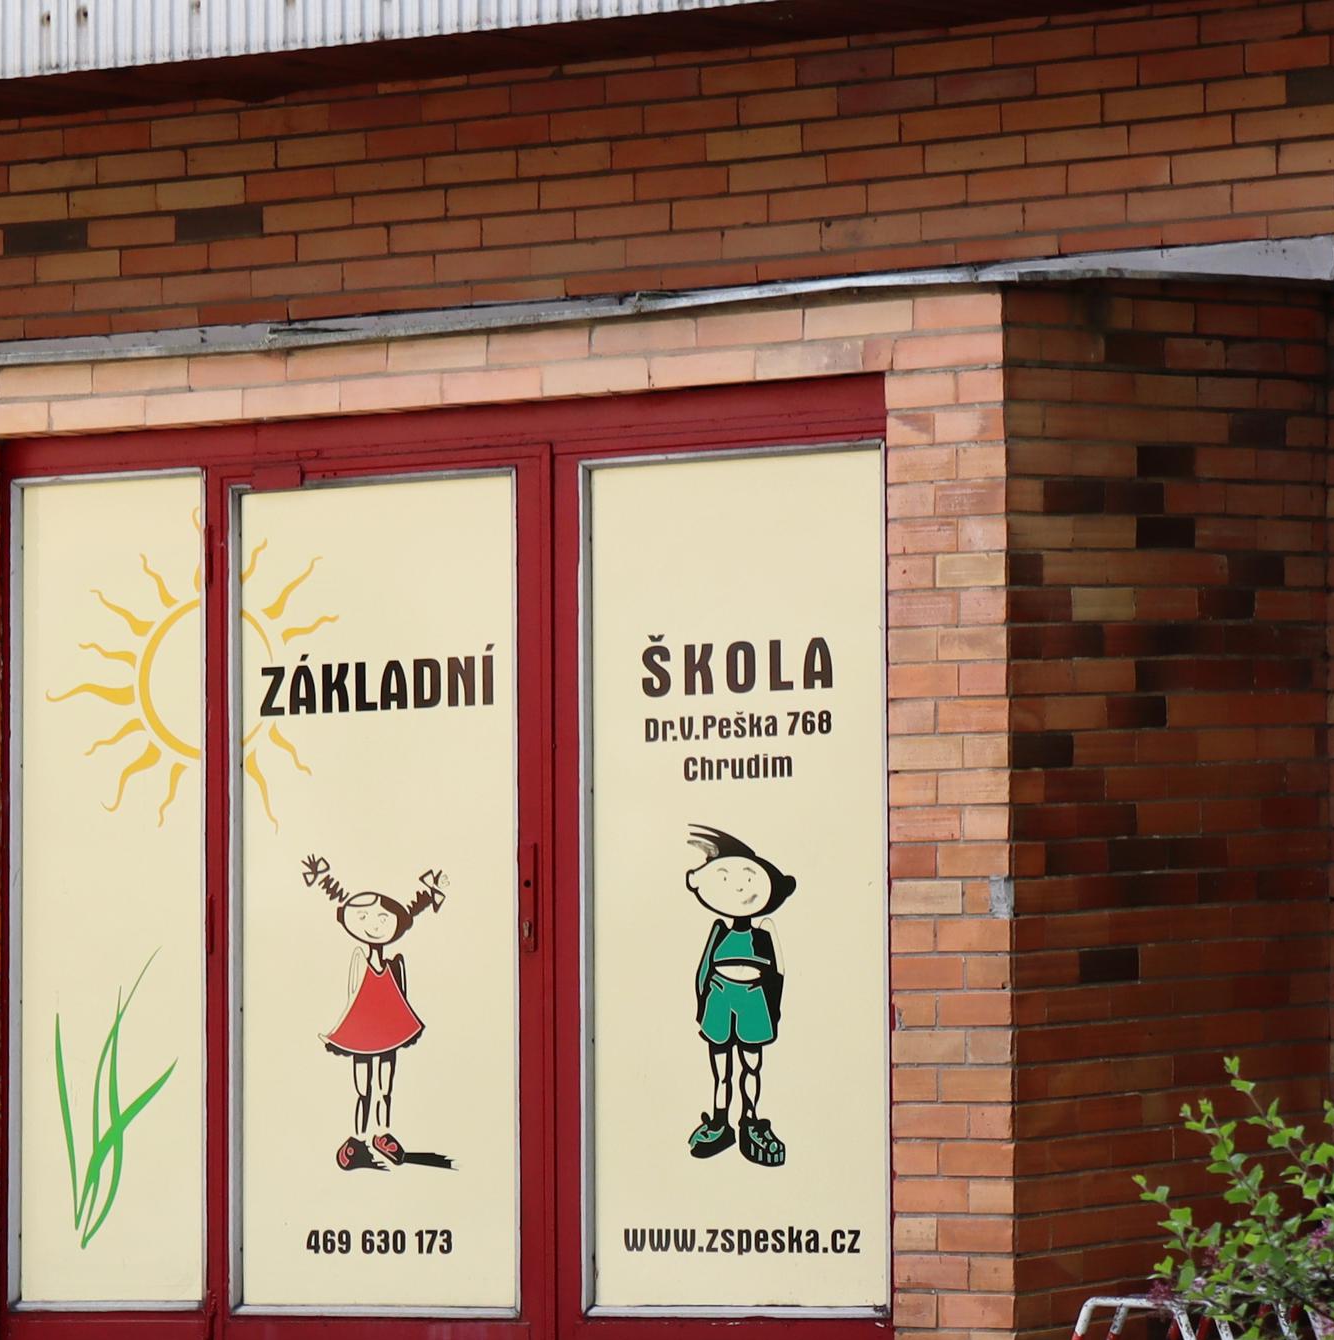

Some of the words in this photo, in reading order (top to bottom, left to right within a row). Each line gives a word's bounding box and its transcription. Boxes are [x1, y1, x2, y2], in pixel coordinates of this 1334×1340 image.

[260, 643, 495, 717] ZÁKLADNÍ
[641, 634, 833, 698] ŠKOLA
[645, 711, 778, 743] Dr.V.Peška
[787, 710, 832, 736] 768
[683, 753, 793, 782] Chrudim
[306, 1229, 351, 1254] 469
[361, 1229, 406, 1254] 630
[414, 1229, 453, 1254] 173
[623, 1226, 861, 1256] www.zspeska.cz
